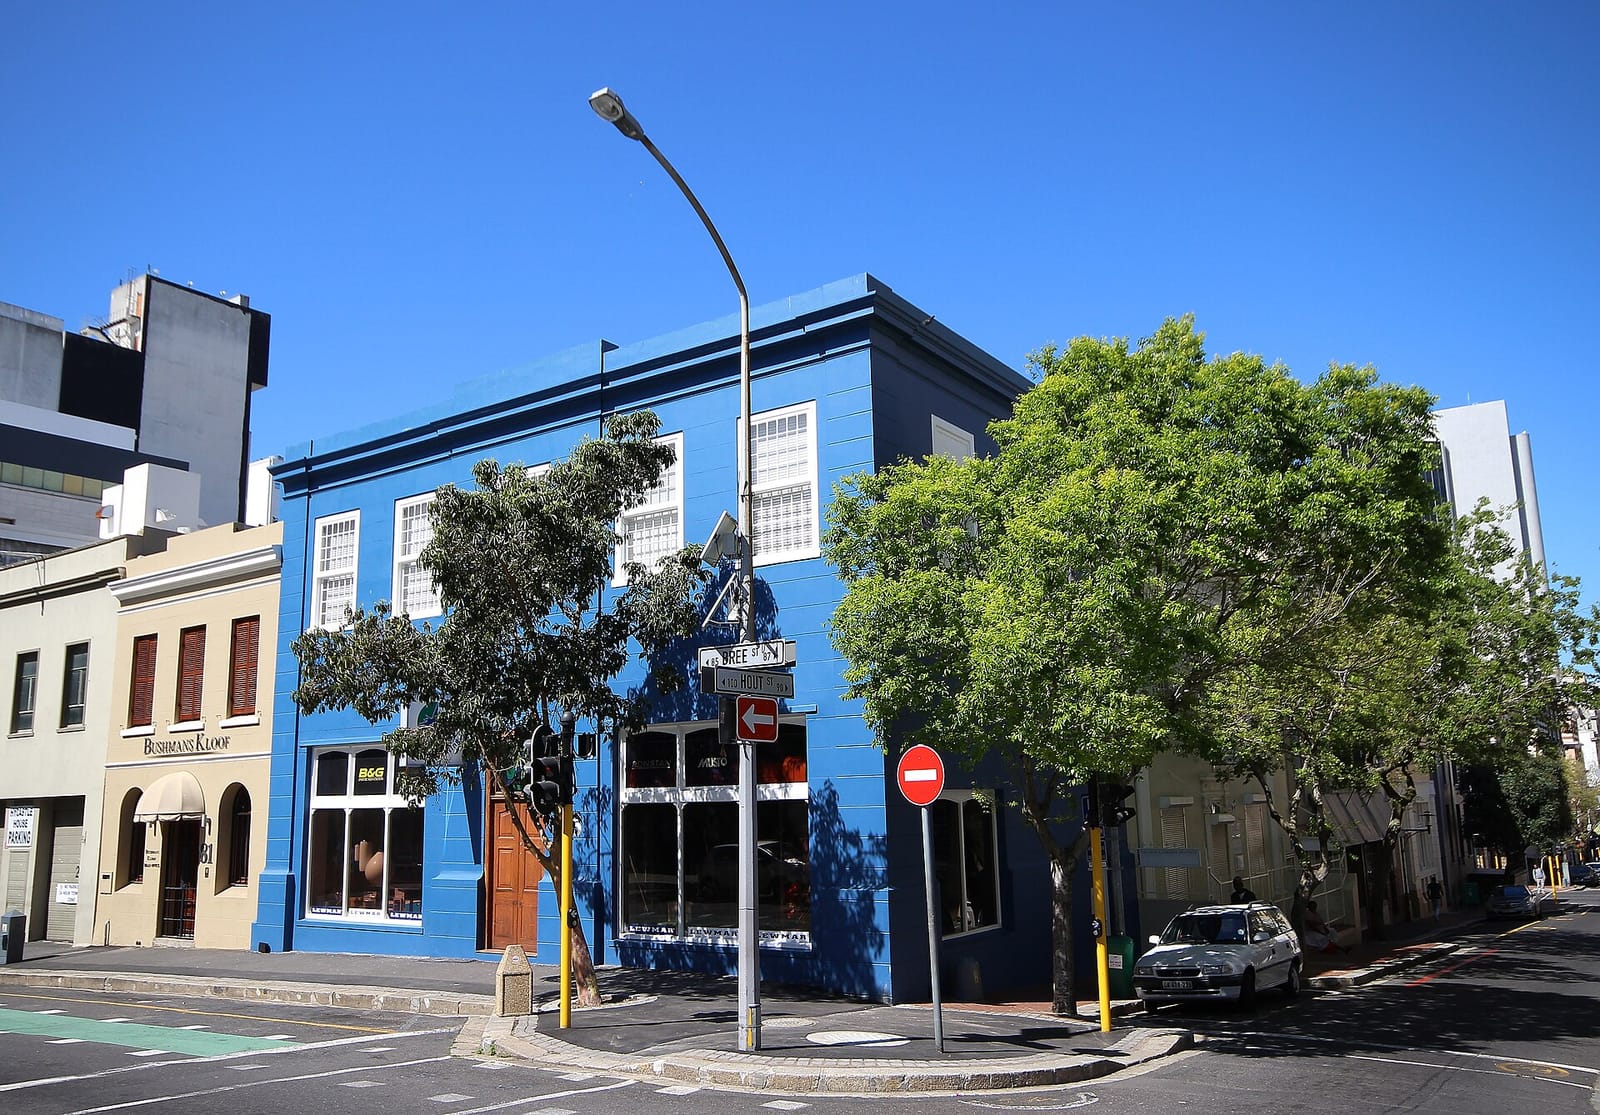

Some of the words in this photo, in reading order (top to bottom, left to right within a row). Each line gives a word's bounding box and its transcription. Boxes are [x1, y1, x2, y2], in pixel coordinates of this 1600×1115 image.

[722, 649, 747, 665] BREE
[751, 647, 759, 657] ST
[763, 652, 771, 661] 87
[740, 674, 763, 690] HOUT
[766, 677, 773, 686] ST
[698, 757, 727, 768] MUSTO
[358, 767, 385, 777] B&G
[13, 819, 28, 828] HOUSE
[8, 831, 31, 844] PARKING
[629, 925, 675, 934] LEWMAR
[690, 928, 738, 937] LEWMAR
